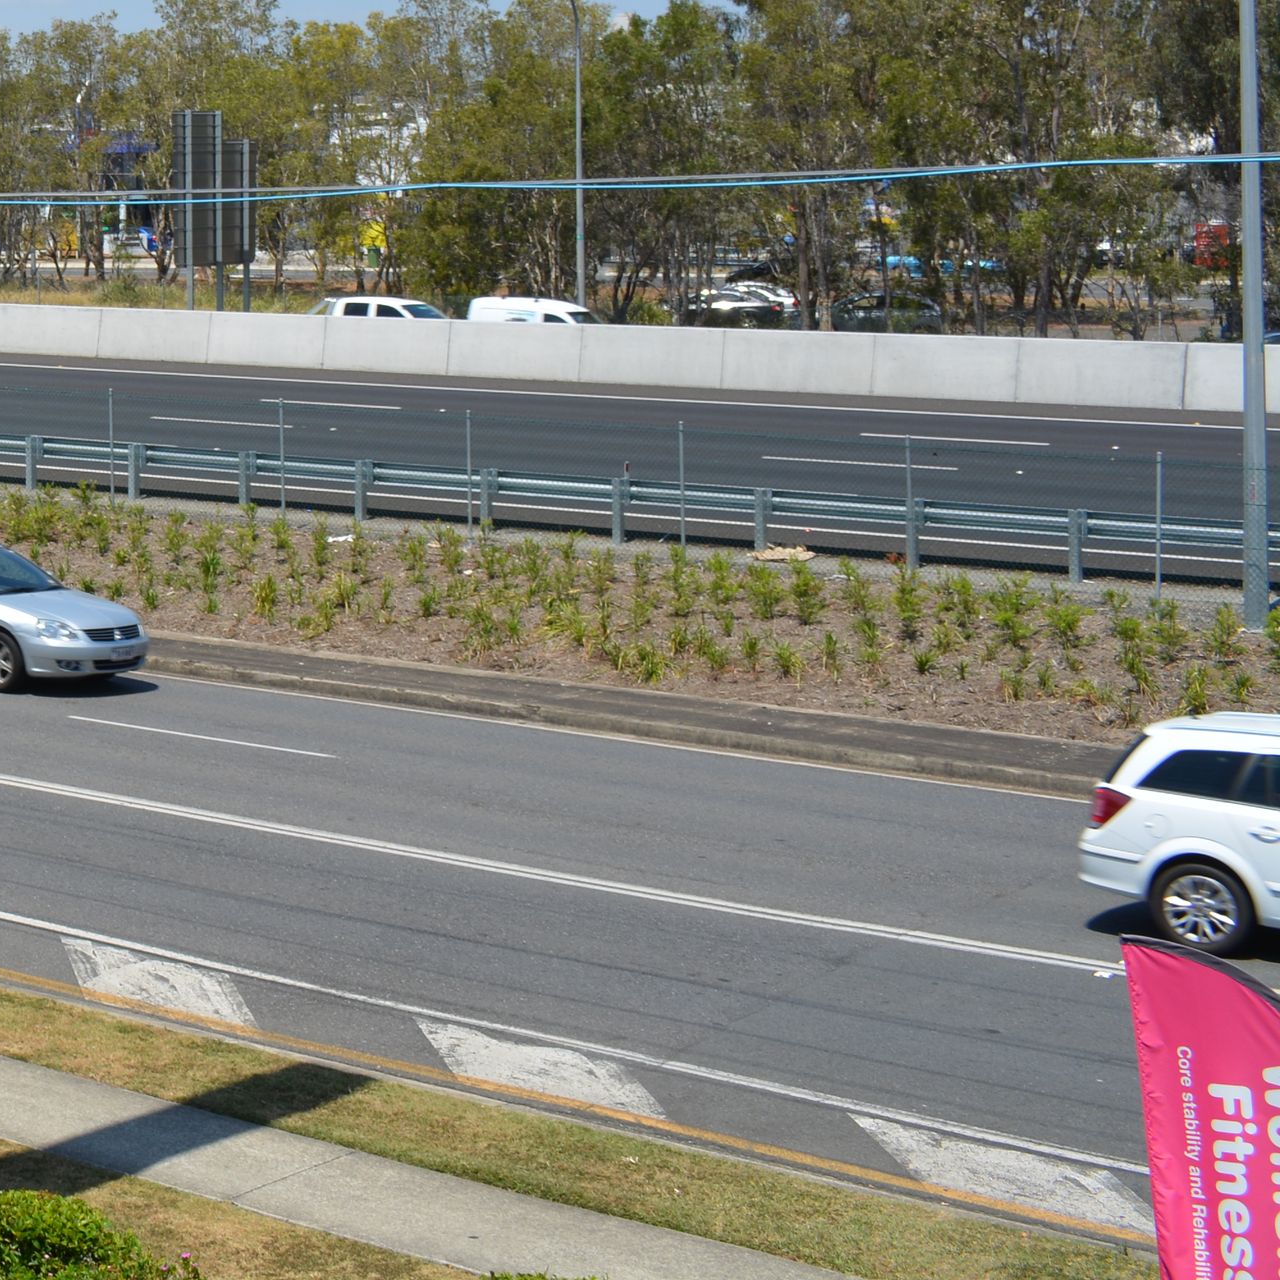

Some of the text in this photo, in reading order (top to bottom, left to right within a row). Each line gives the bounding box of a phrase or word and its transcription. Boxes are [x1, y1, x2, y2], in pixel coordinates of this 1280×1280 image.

[1176, 1046, 1192, 1087] Core
[1181, 1092, 1201, 1161] stability
[1189, 1165, 1206, 1199] and
